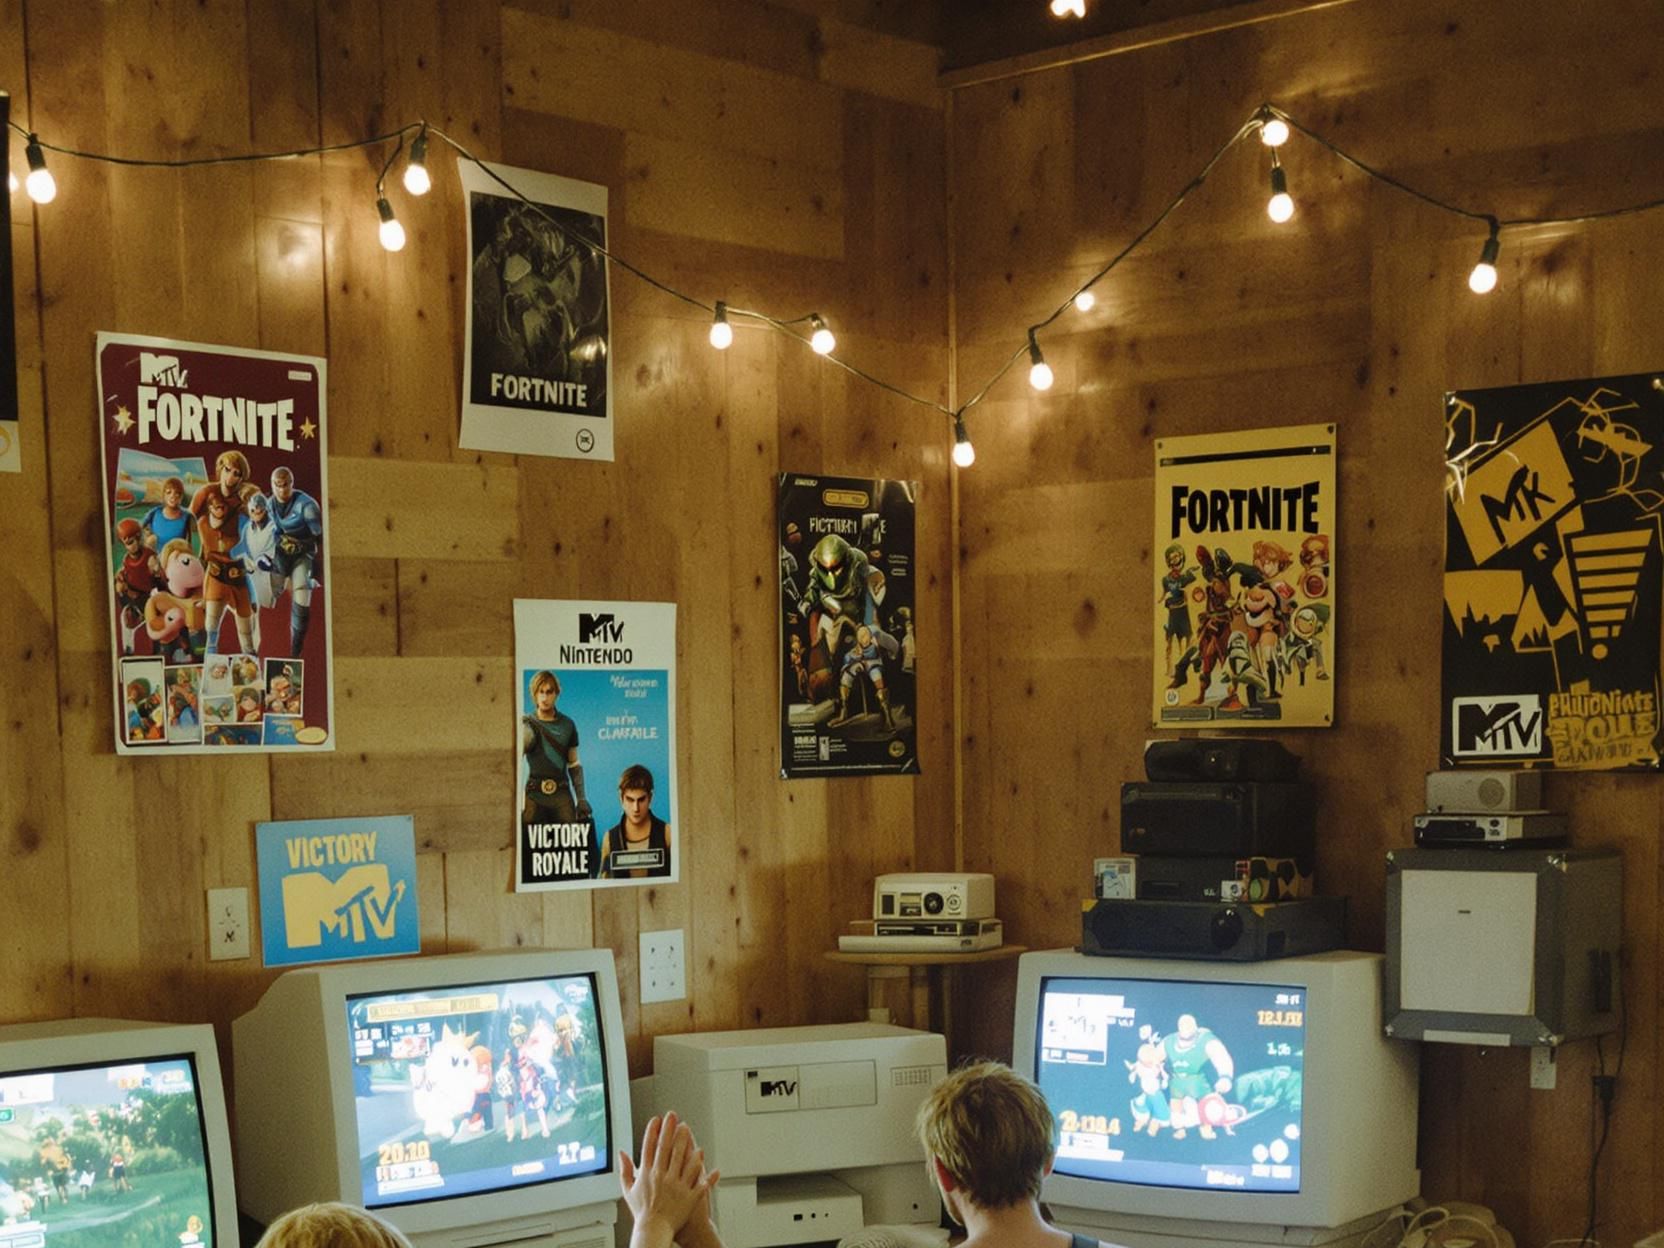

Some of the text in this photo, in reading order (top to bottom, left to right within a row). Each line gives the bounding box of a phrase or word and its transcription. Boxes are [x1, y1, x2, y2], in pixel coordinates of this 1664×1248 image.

[140, 352, 188, 388] MTV
[491, 373, 587, 407] FORTNITE
[138, 385, 294, 452] FORTNITE
[1172, 481, 1321, 539] FORTNITE
[578, 613, 624, 643] MTV
[1458, 702, 1541, 752] MTV
[286, 832, 377, 869] VICTORY
[528, 823, 590, 849] VICTORY
[532, 851, 589, 877] ROYALE
[282, 863, 406, 948] MTV
